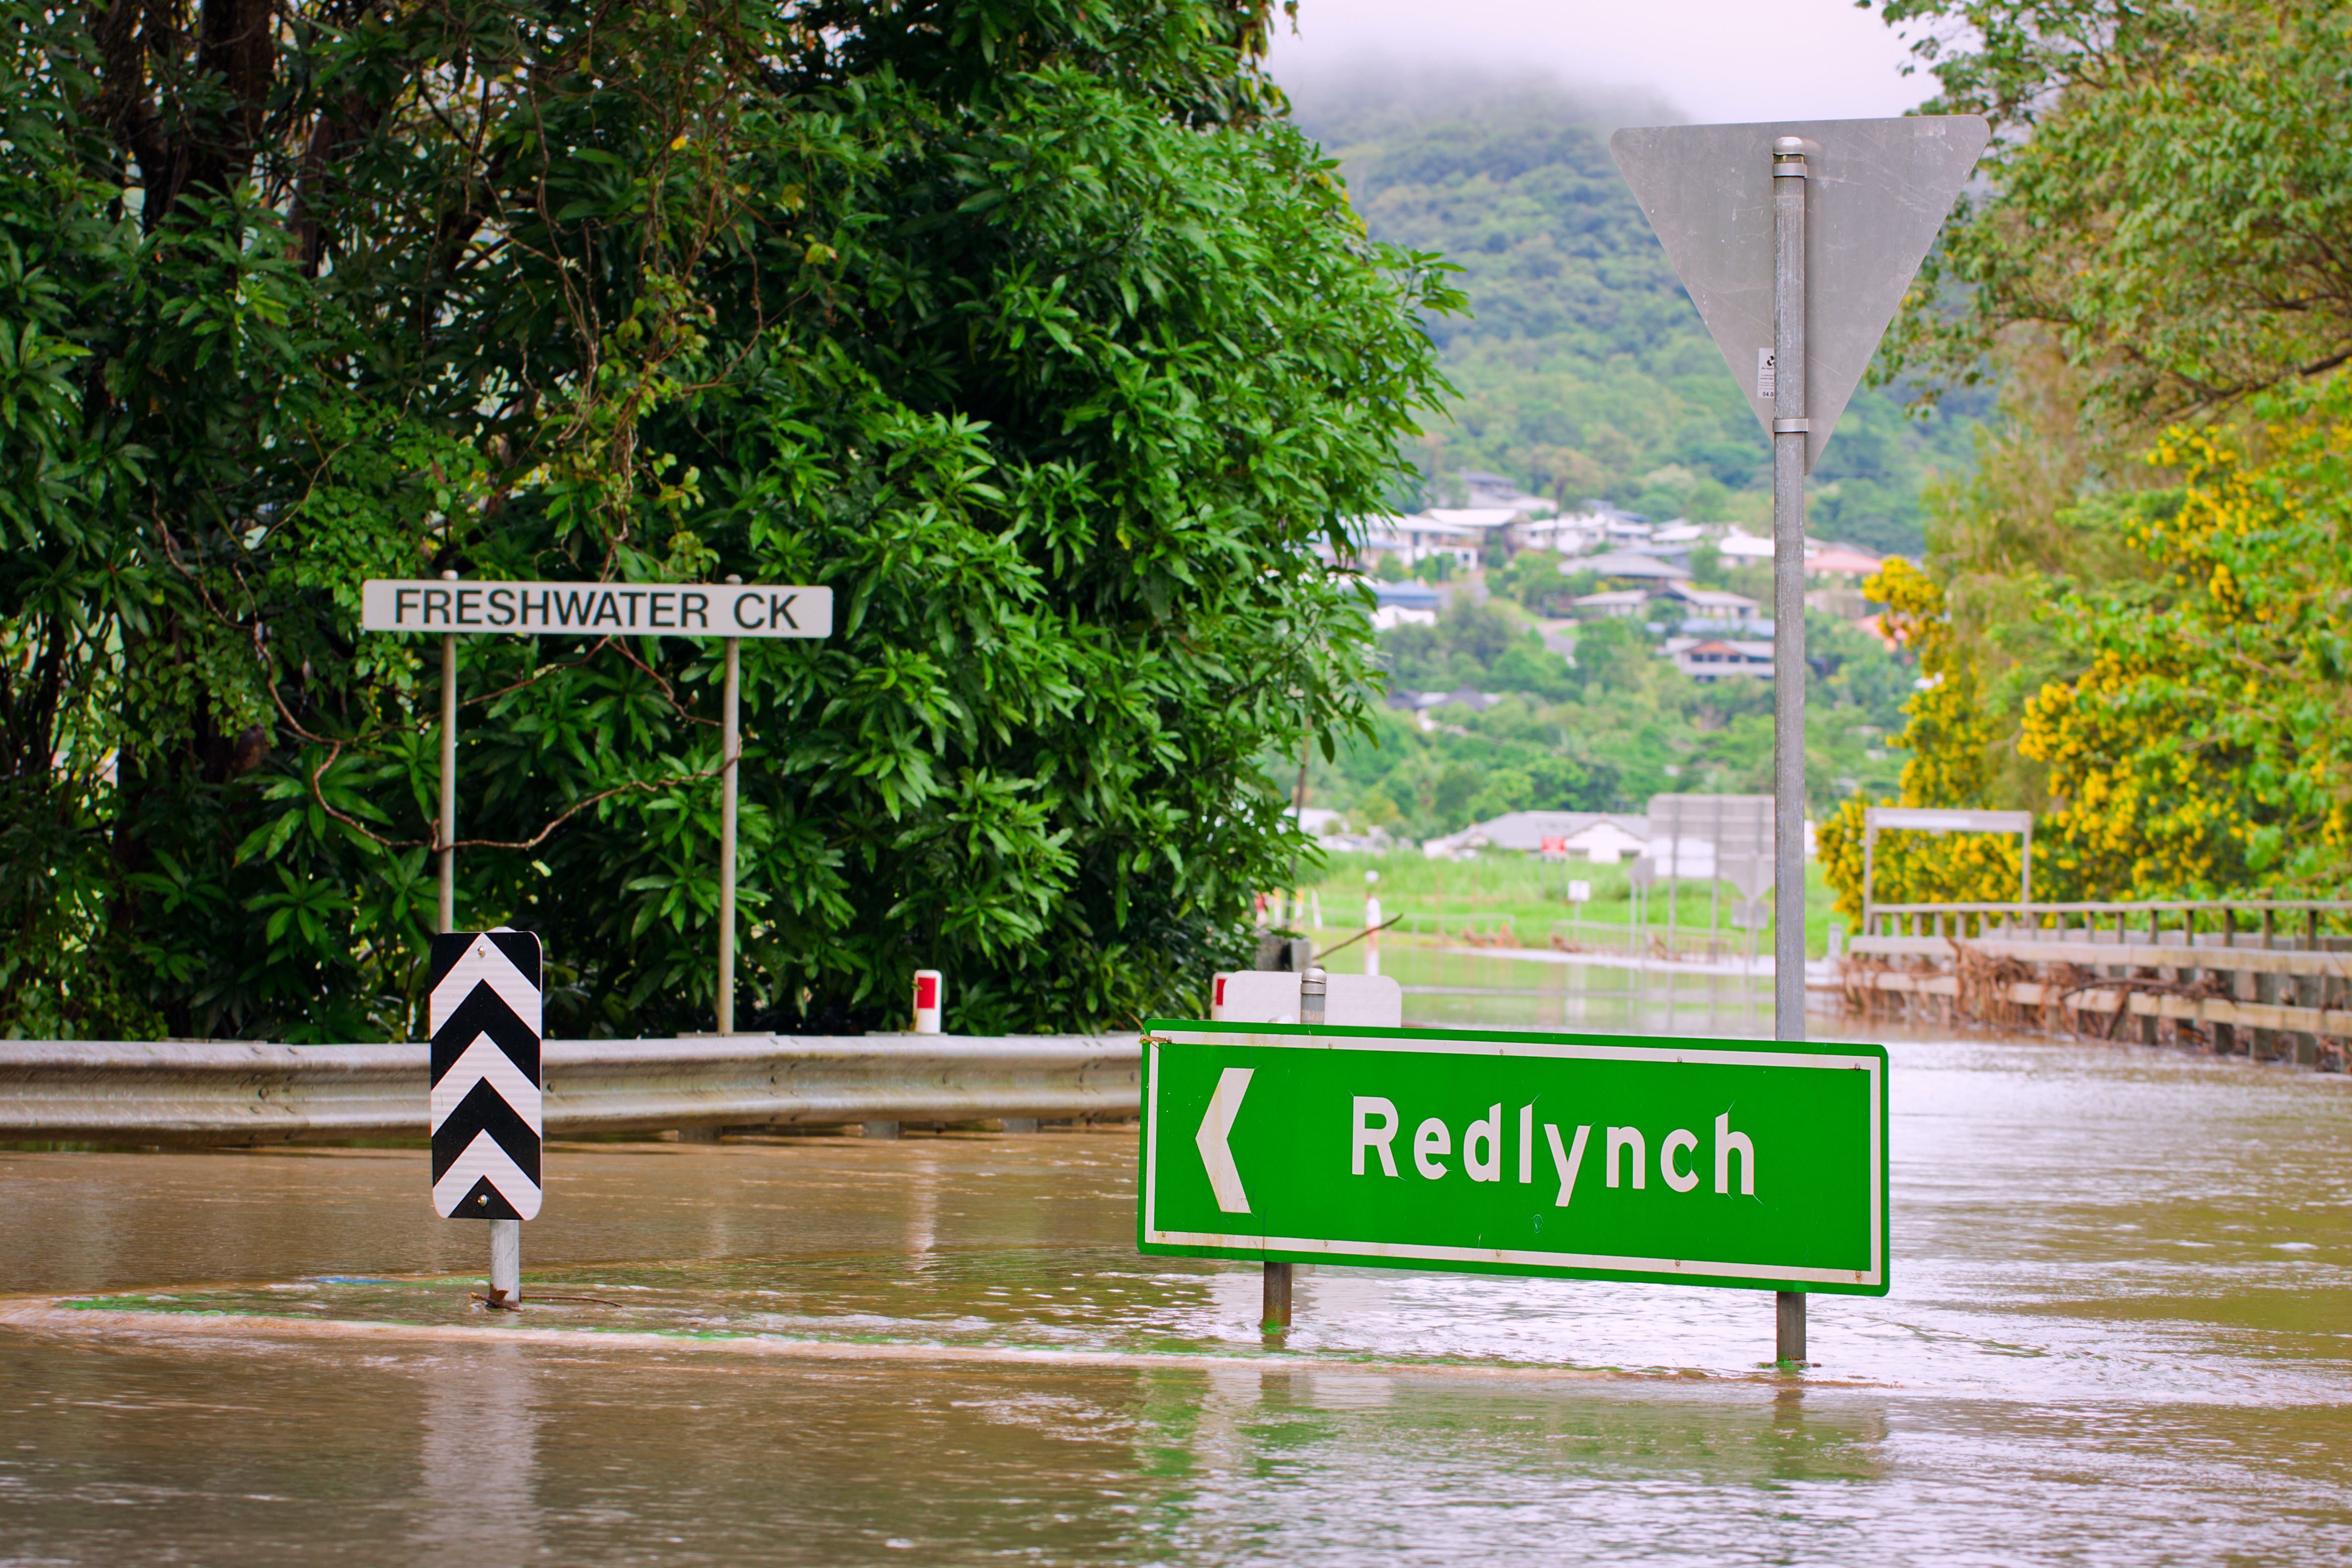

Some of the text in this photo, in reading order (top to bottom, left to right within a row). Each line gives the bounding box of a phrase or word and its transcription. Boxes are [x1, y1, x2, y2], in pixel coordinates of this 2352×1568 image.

[395, 588, 799, 630] FRESHWATER CK
[1352, 1096, 1755, 1207] Redlynch
